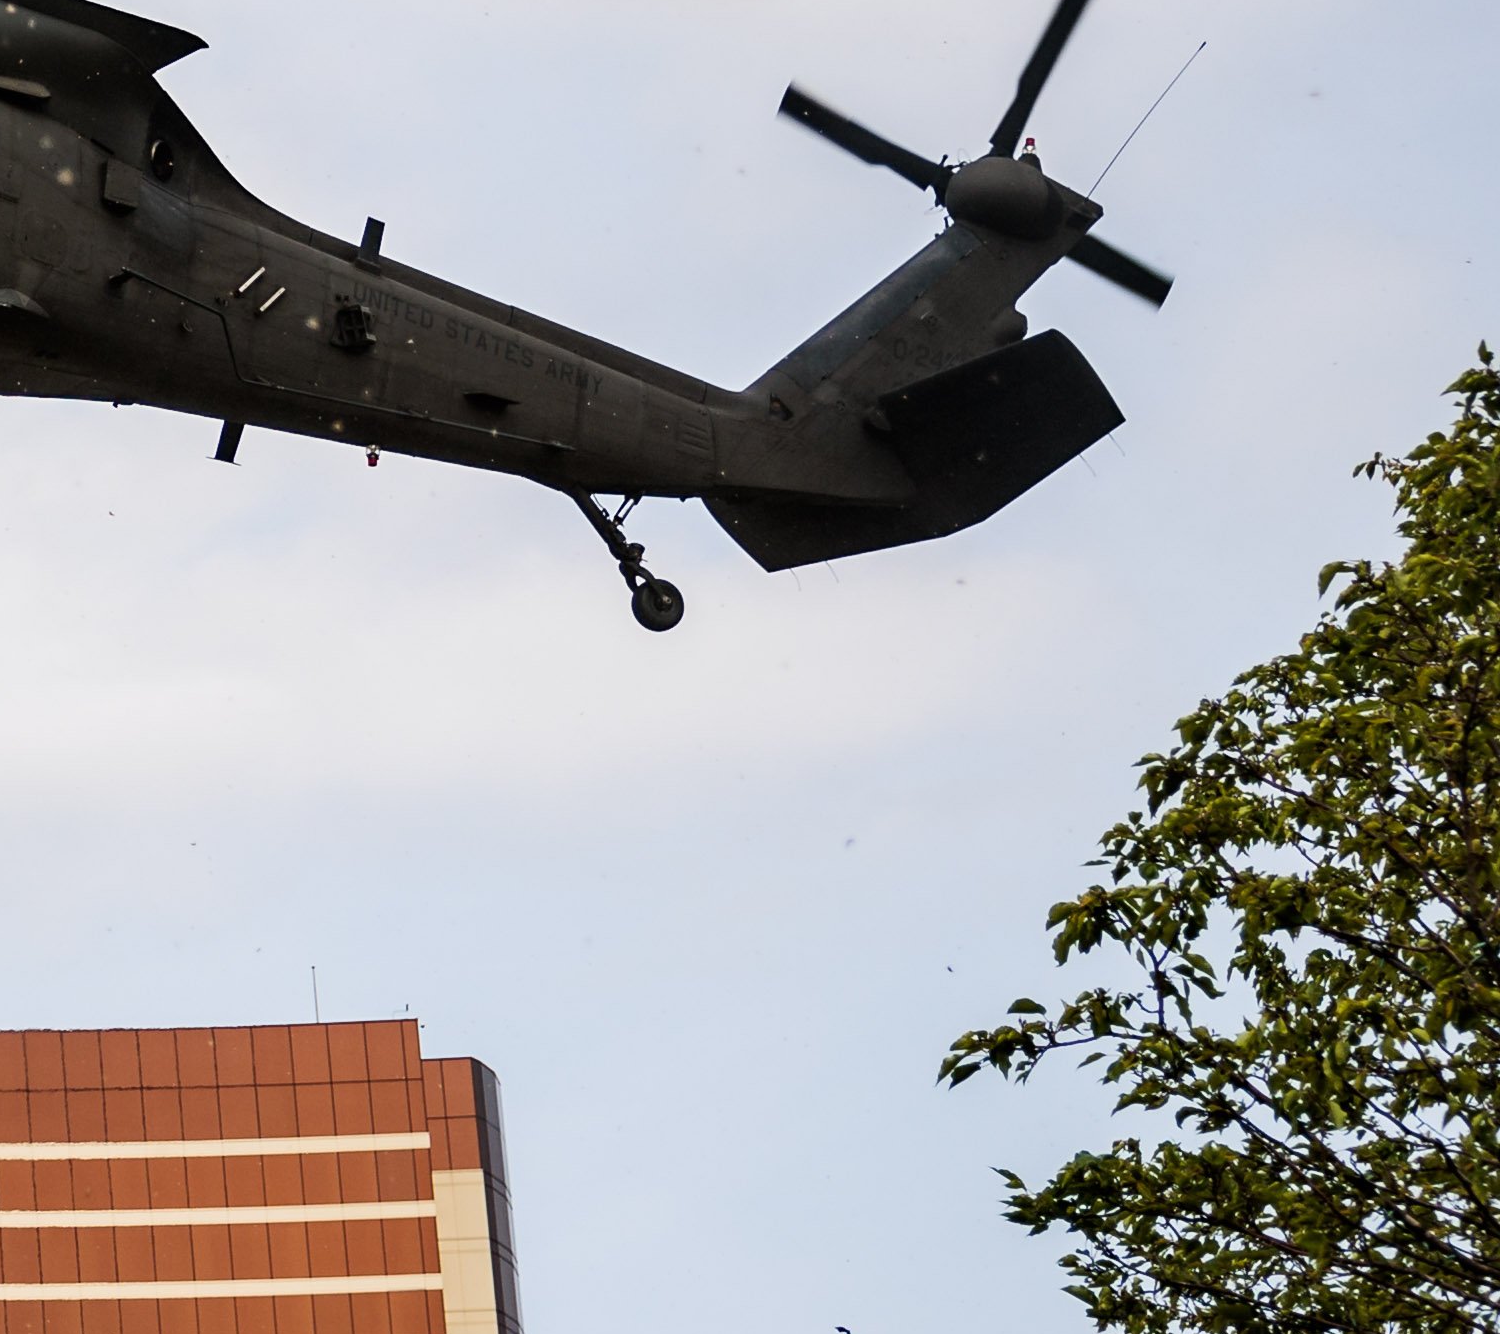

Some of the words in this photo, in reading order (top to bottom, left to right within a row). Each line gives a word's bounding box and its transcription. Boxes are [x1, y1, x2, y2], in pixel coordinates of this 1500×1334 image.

[353, 282, 434, 329] UNITED
[444, 320, 535, 368] STATES
[545, 359, 603, 394] ARMY
